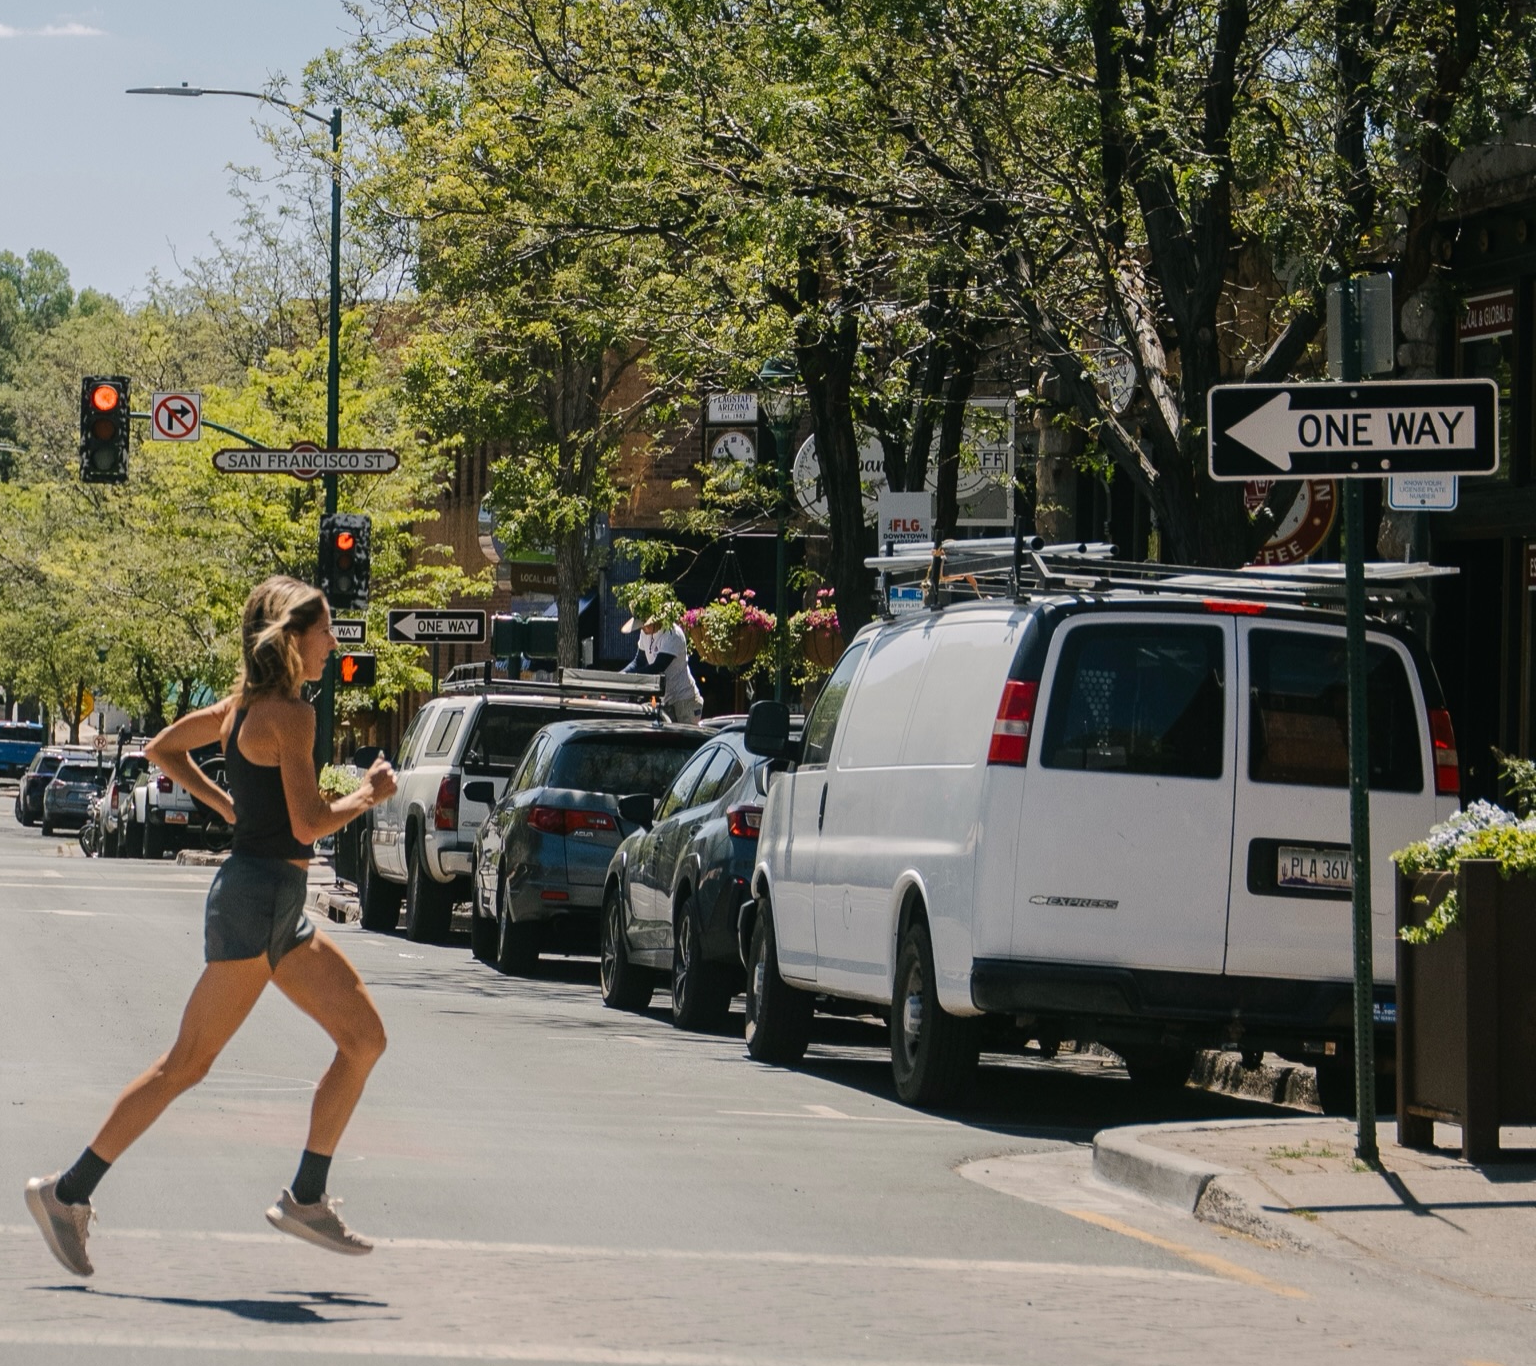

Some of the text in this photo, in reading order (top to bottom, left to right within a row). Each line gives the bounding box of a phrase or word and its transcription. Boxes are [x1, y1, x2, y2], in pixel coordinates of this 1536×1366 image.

[1484, 304, 1506, 326] GLOBAL
[718, 403, 749, 412] ARIZONA
[1298, 411, 1464, 448] ONE WAY
[228, 454, 384, 468] SAN FRANCISCO ST
[520, 573, 543, 584] LOCAL
[338, 626, 358, 636] WAY
[418, 621, 475, 633] ONE WAY
[1291, 857, 1317, 878] PLA
[1046, 896, 1119, 910] EXPRESS
